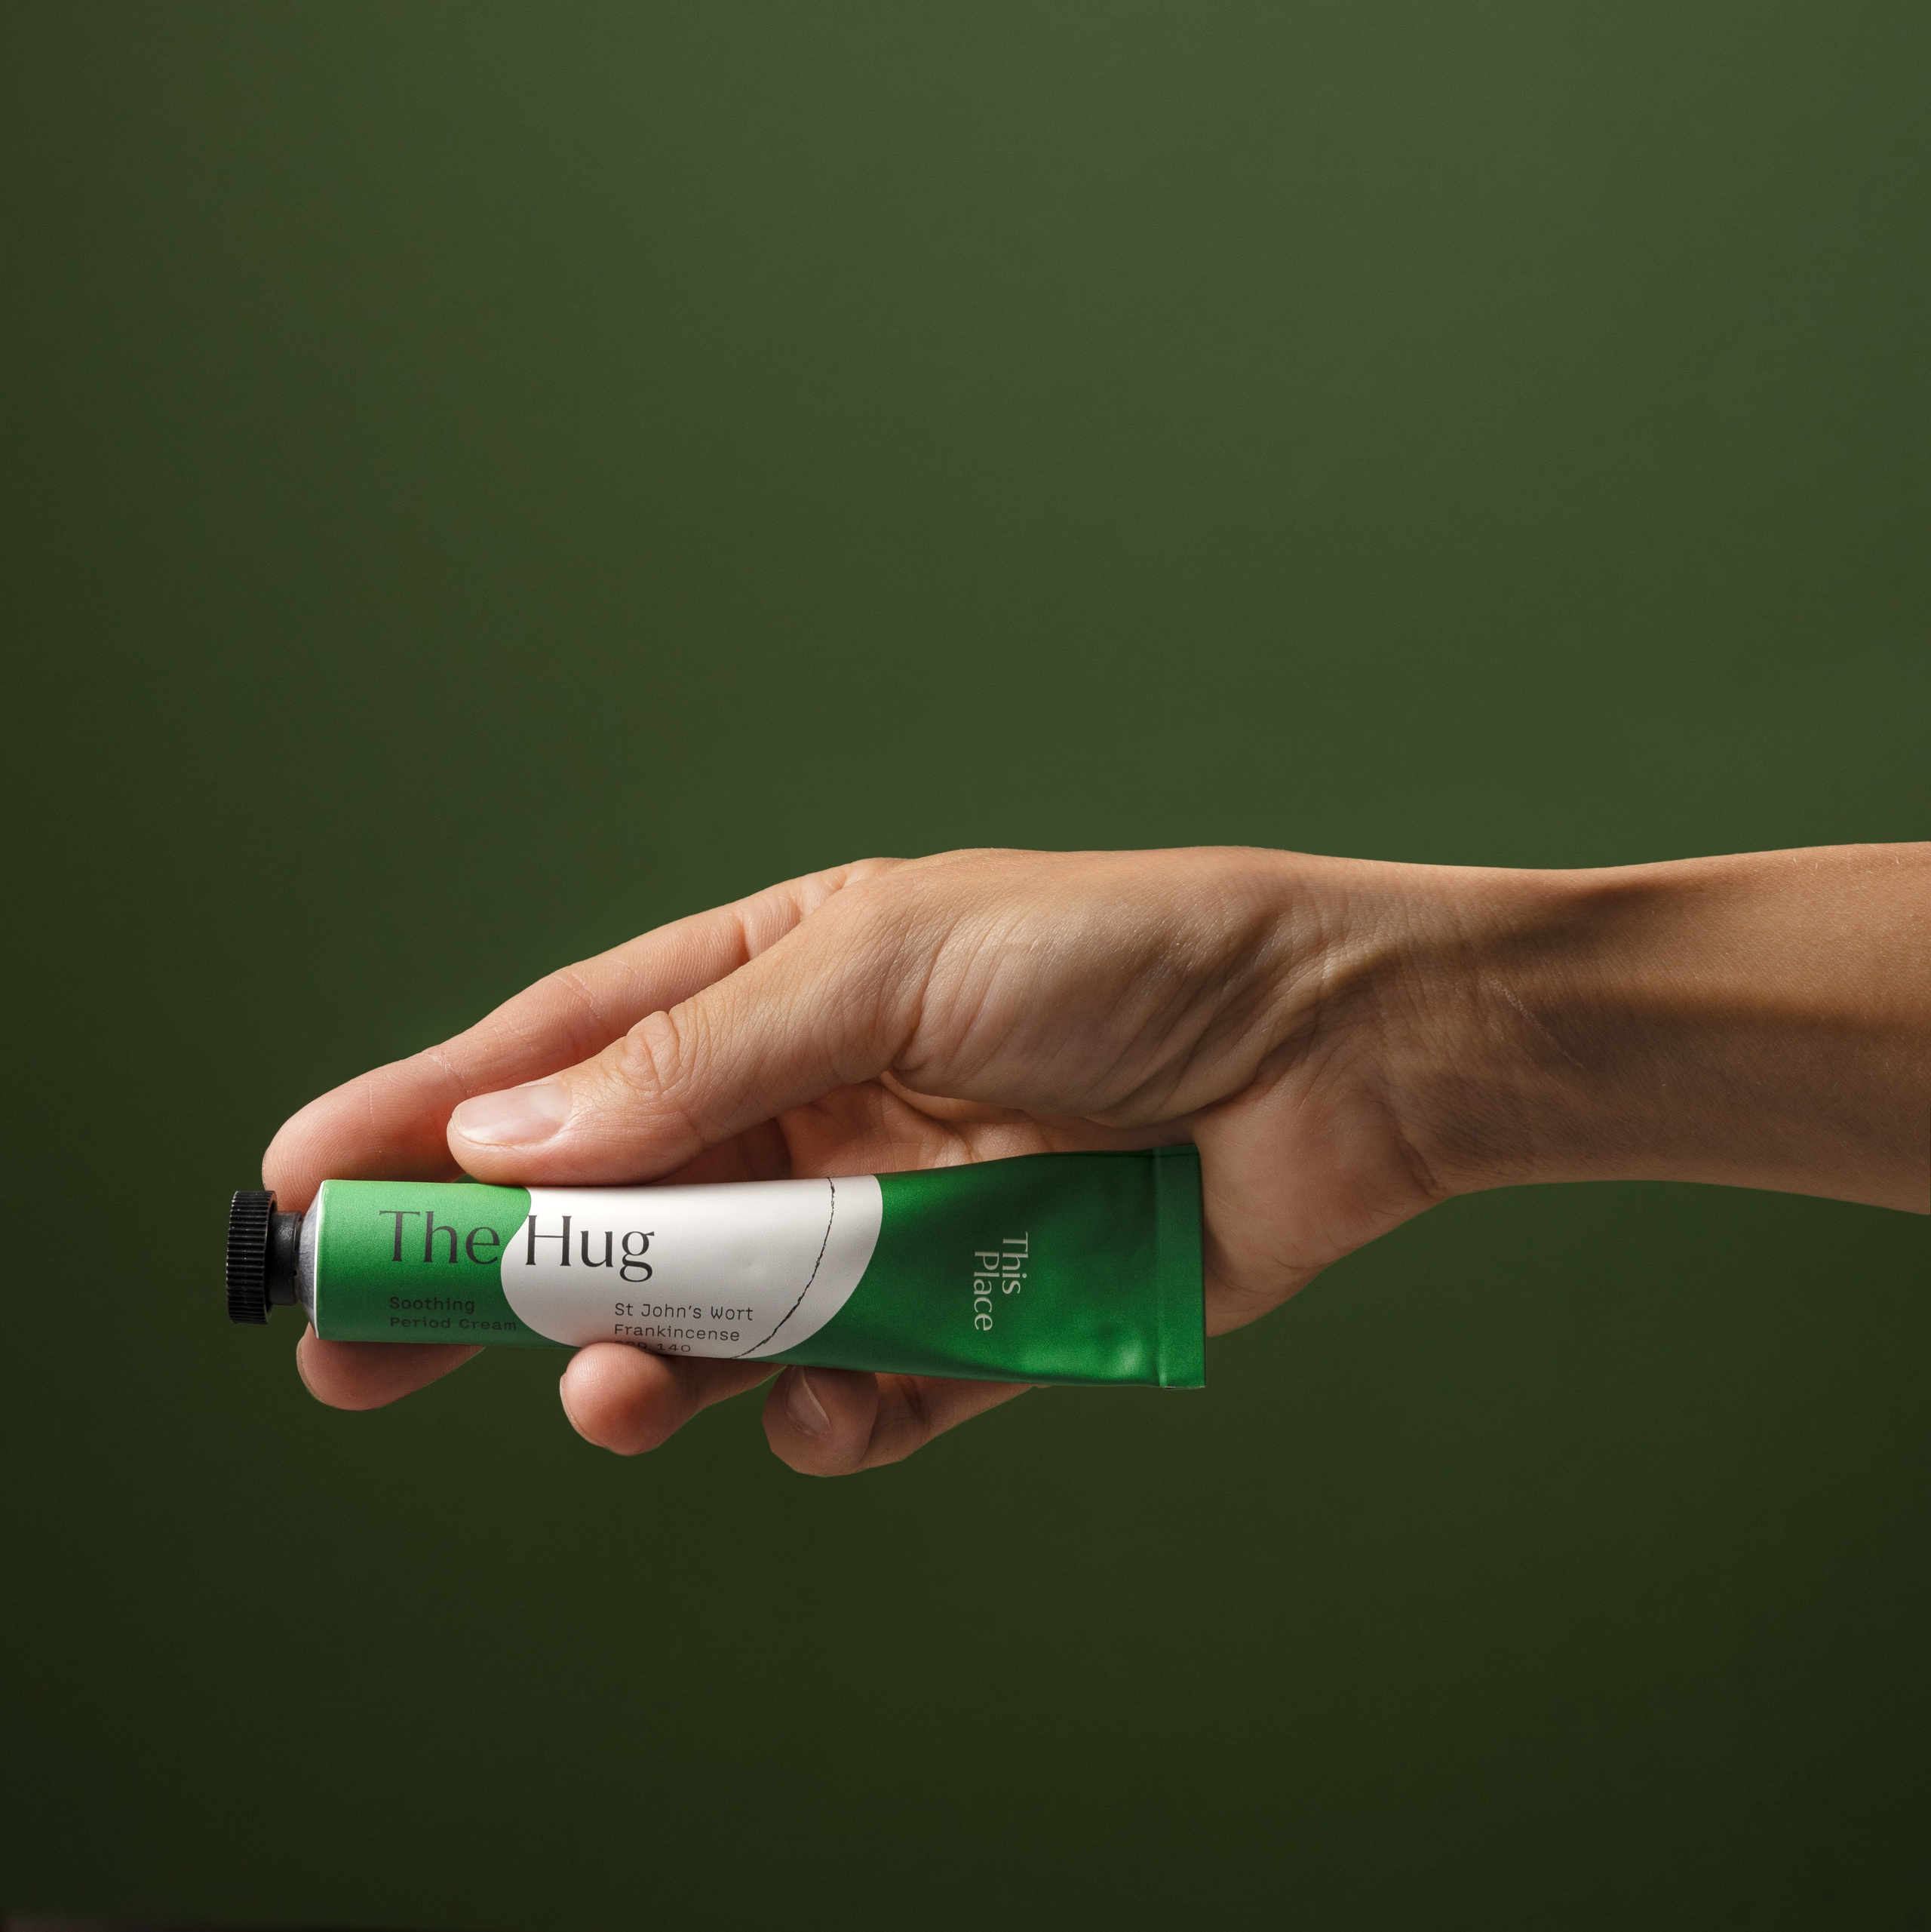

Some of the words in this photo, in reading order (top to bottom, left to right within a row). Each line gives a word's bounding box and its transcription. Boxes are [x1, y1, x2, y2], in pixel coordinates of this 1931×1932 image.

[379, 1210, 501, 1265] The
[525, 1215, 655, 1282] Hug
[1002, 1232, 1028, 1295] This
[973, 1251, 999, 1332] Place
[389, 1296, 475, 1314] Soothing
[615, 1303, 634, 1316] St
[641, 1304, 701, 1319] John's
[711, 1307, 754, 1321] Wort
[389, 1317, 451, 1328] Period
[459, 1318, 517, 1330] Cream
[614, 1324, 740, 1341] Frankincense
[657, 1343, 691, 1353] 140
